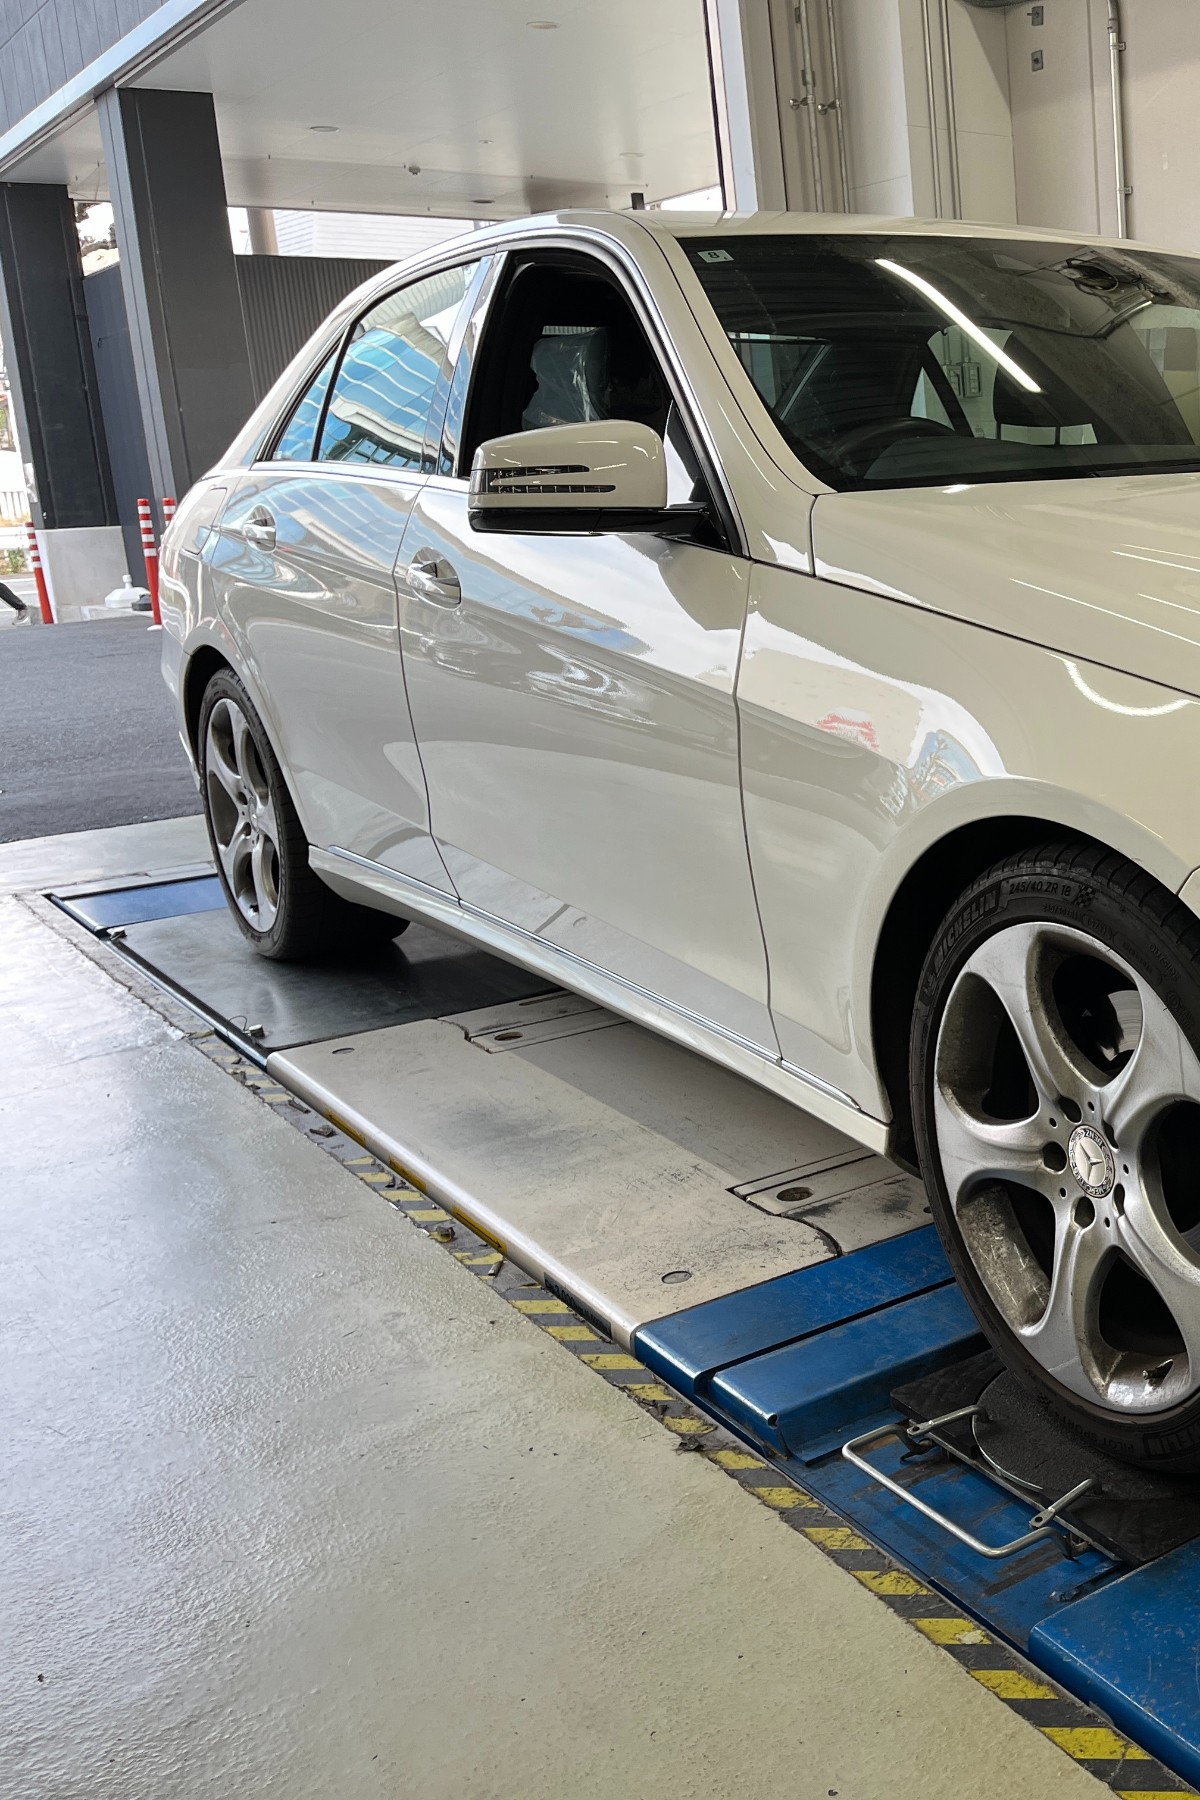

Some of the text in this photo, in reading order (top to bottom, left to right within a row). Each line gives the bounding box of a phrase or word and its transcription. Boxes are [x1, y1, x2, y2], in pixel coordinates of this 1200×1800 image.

[1009, 881, 1072, 897] 245/40 ZR 18
[933, 889, 997, 973] MICHELIN
